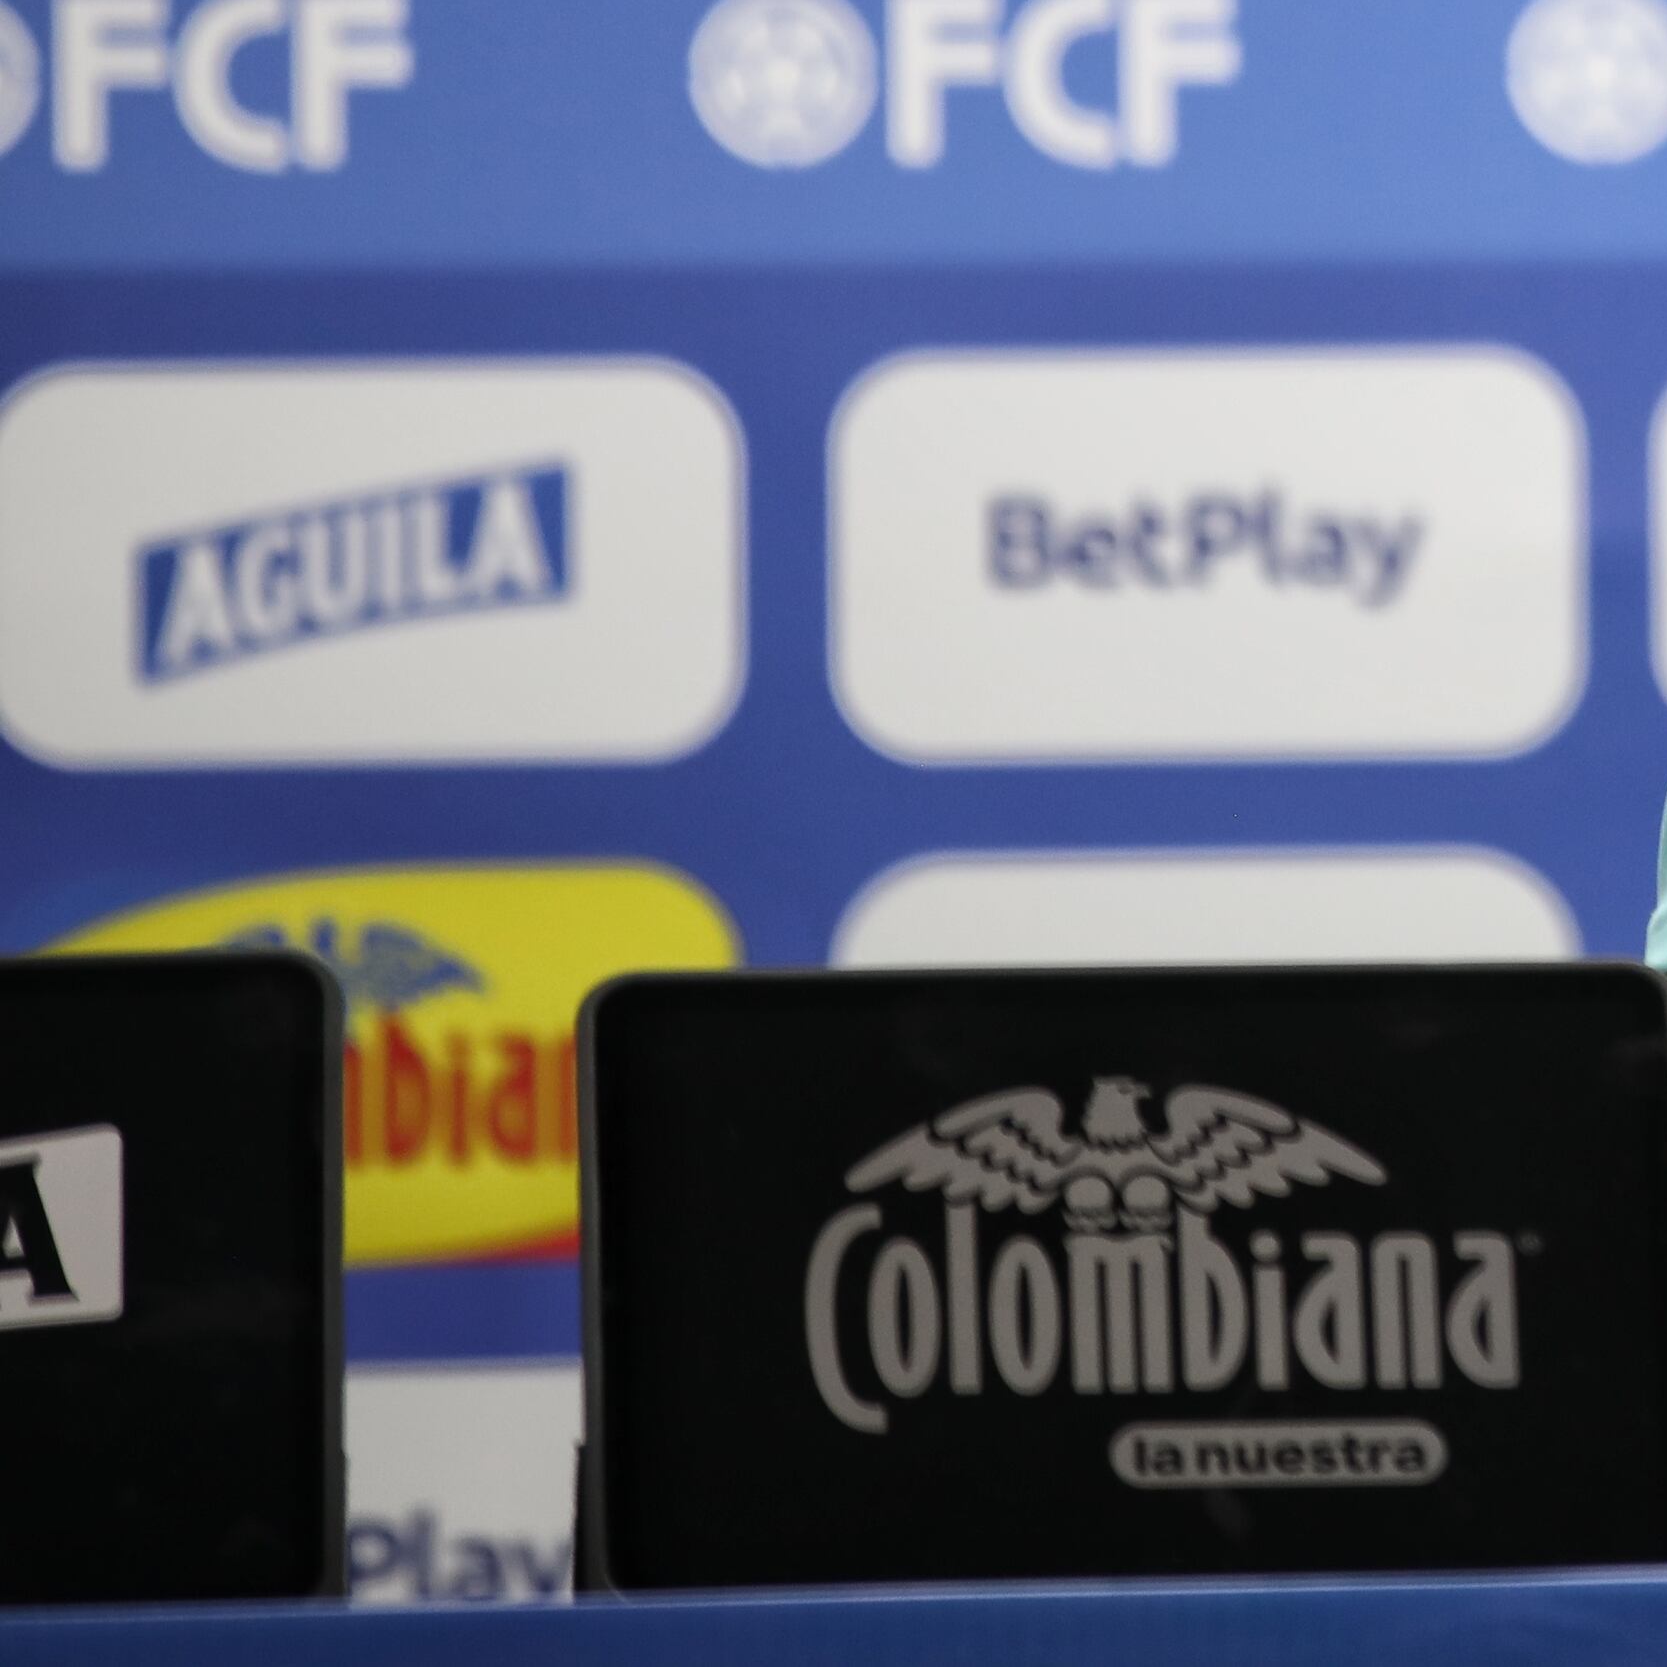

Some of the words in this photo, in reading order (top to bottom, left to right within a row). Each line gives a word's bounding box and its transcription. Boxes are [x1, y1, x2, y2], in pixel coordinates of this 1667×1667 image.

[150, 472, 560, 674] AGUILA
[982, 494, 1425, 624] BetPlay
[805, 1200, 1520, 1434] Colombiana
